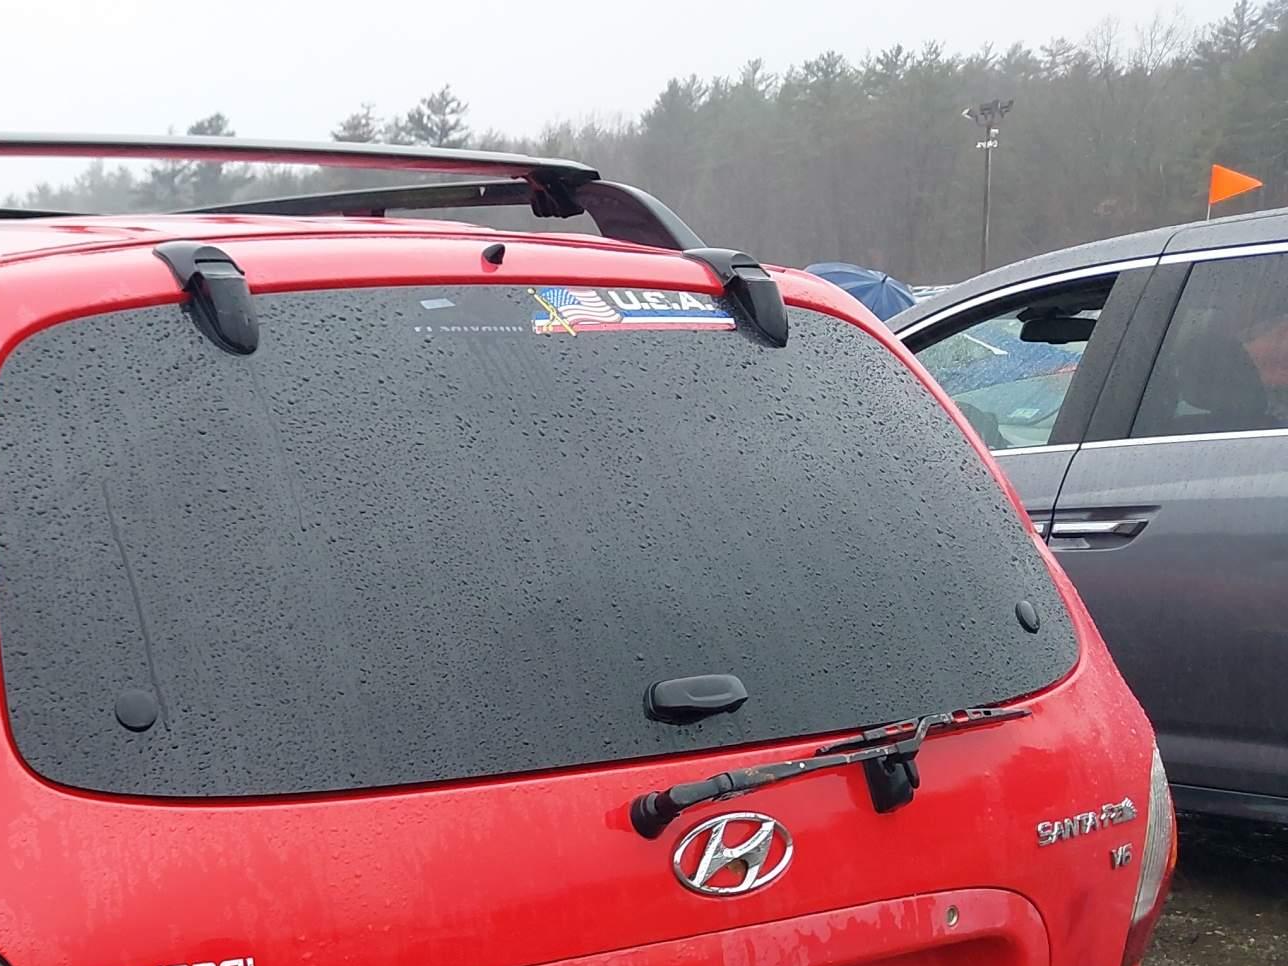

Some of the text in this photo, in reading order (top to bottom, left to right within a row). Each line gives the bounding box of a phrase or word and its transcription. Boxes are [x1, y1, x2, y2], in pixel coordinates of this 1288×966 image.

[607, 290, 716, 311] U.S.A.
[1037, 811, 1097, 846] SANTA
[1110, 843, 1133, 870] V6
